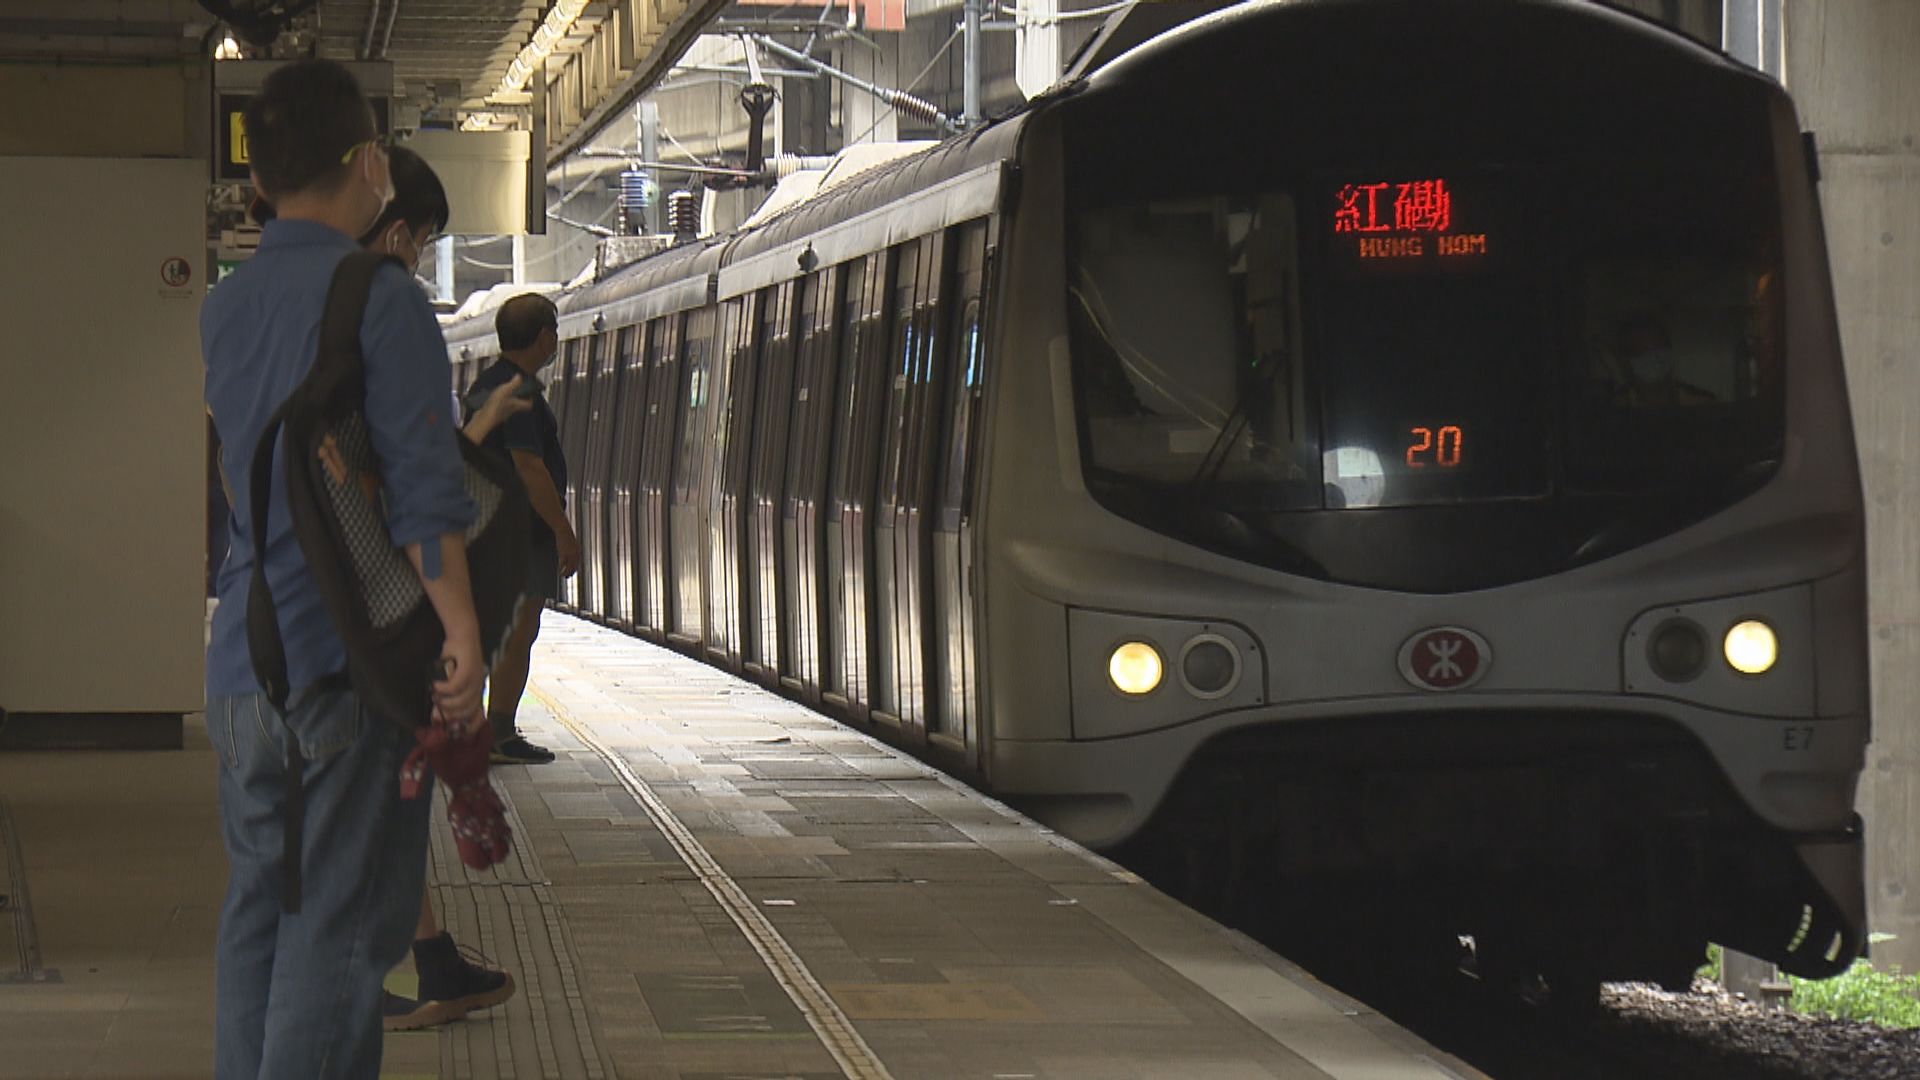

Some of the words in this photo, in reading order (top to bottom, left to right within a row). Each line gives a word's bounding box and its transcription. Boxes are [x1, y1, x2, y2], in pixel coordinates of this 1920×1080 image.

[1335, 178, 1450, 232] 紅磡
[1359, 236, 1423, 258] HUNG
[1438, 233, 1486, 256] HOM
[1406, 425, 1462, 467] 20
[1783, 726, 1815, 751] E7
